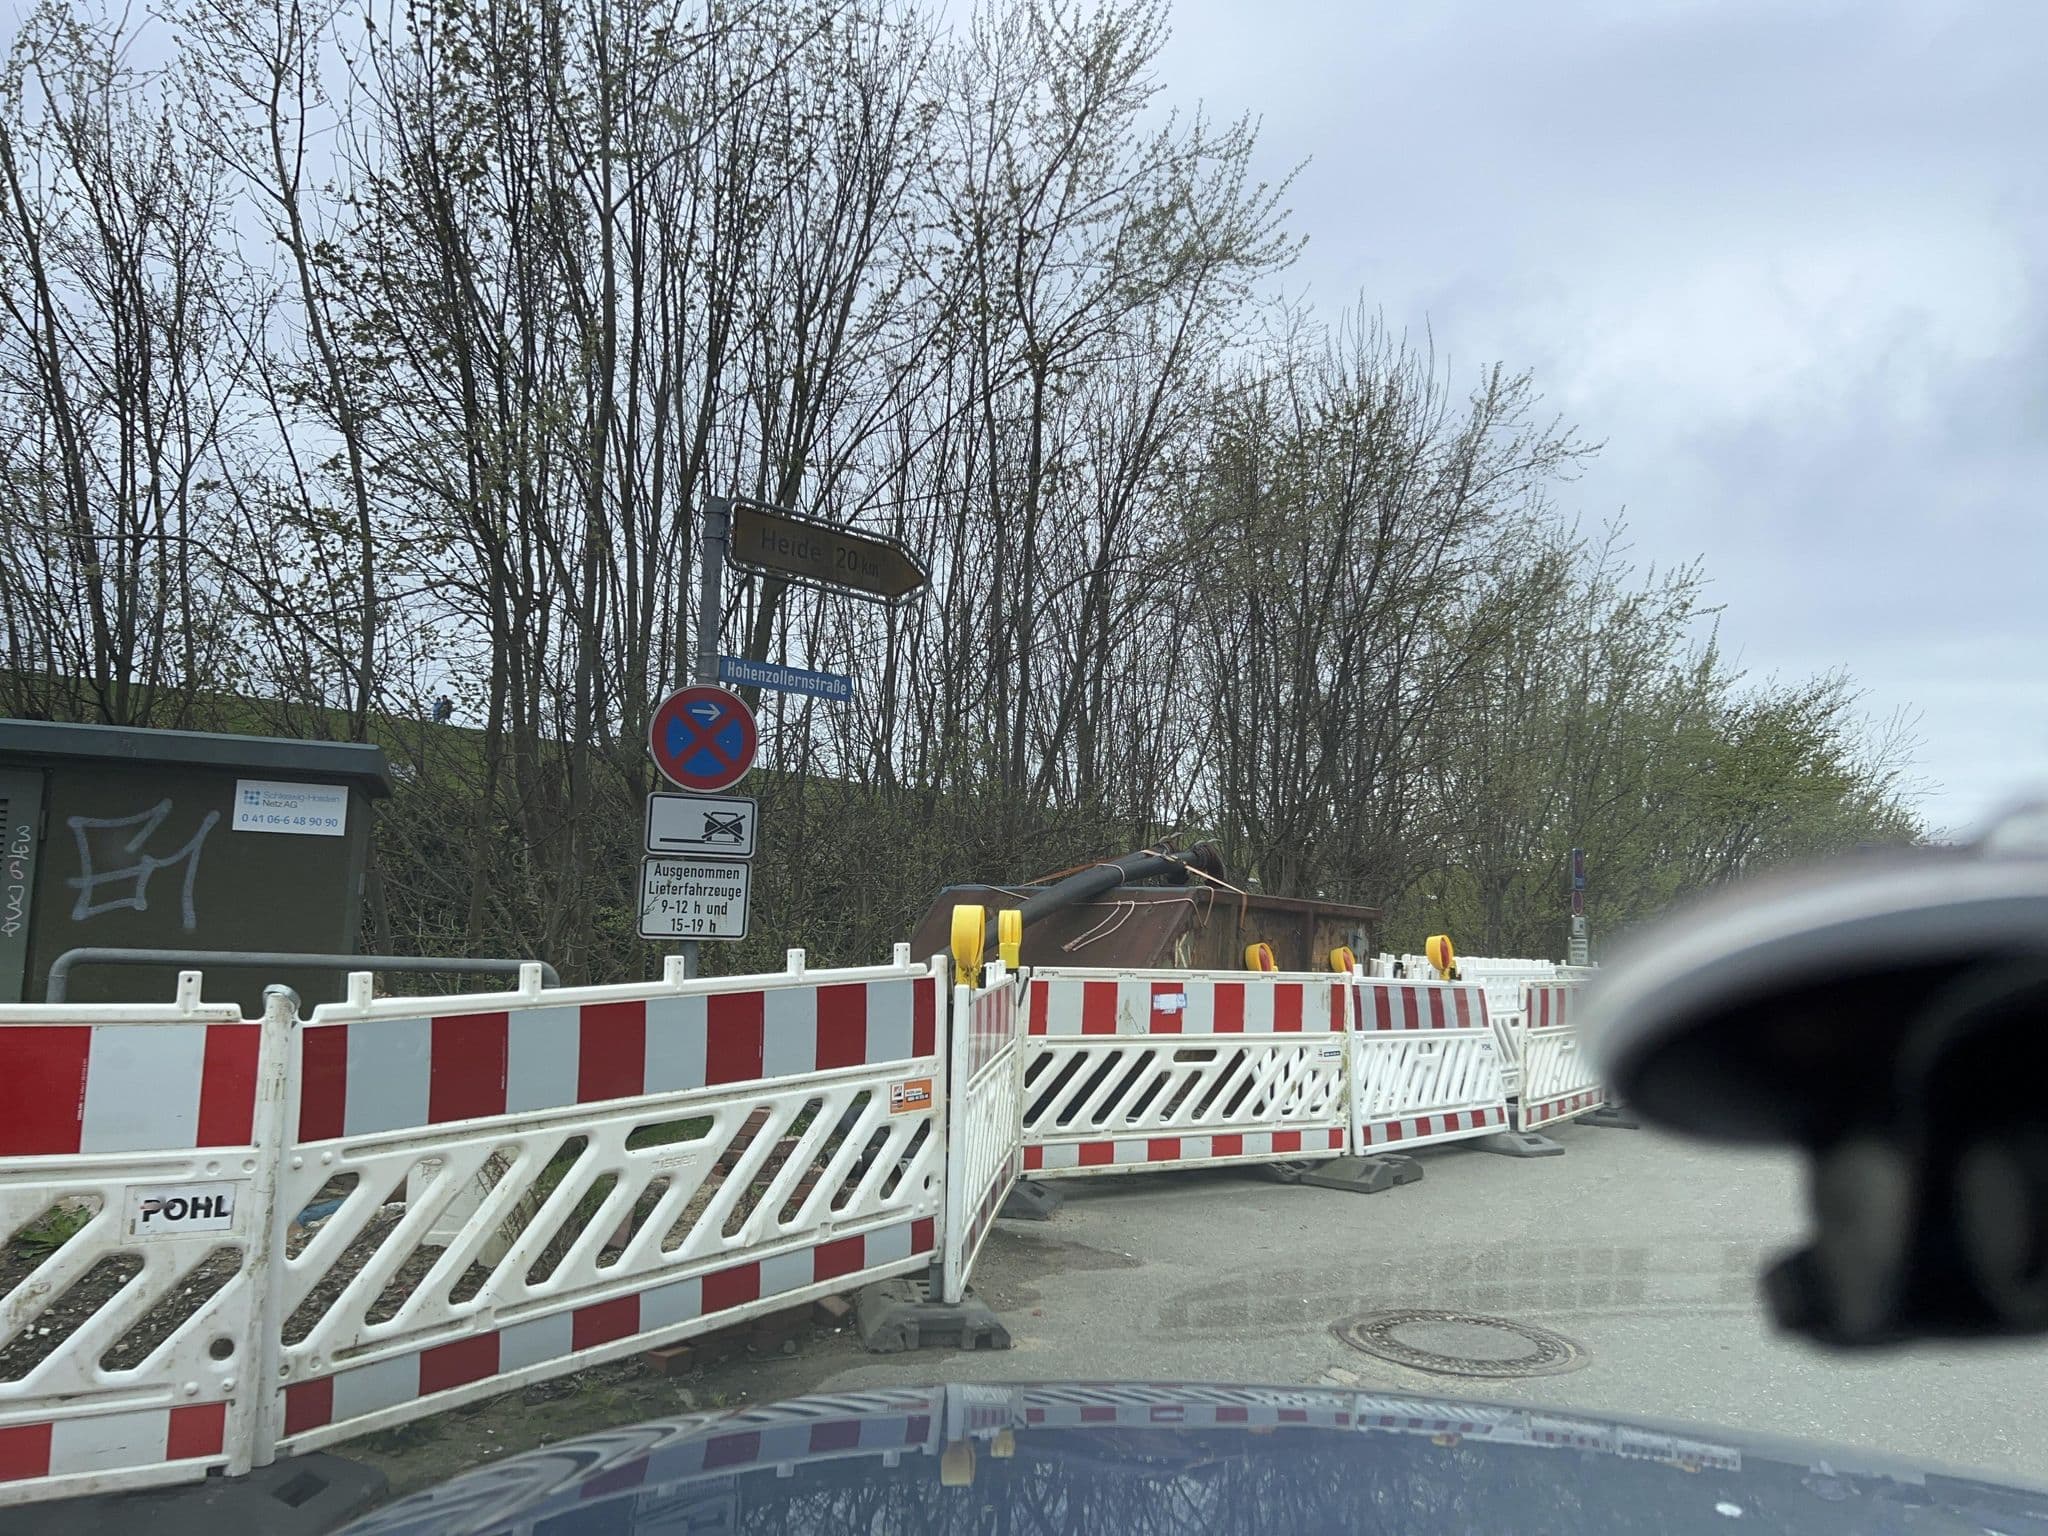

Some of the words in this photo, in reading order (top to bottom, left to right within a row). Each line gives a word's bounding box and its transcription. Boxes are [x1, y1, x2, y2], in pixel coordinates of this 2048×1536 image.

[761, 528, 823, 562] Heide
[836, 547, 857, 571] 20
[862, 557, 880, 577] km
[727, 660, 847, 696] Hohenzollernstraße
[263, 799, 283, 808] Netz
[284, 800, 298, 808] AG
[241, 813, 249, 823] 0
[252, 814, 264, 823] 41
[309, 817, 322, 827] 90
[325, 818, 338, 828] 90
[654, 863, 740, 881] Ausgenommen
[648, 881, 742, 900] Lieferfahrzeuge
[661, 900, 688, 914] 9-12
[694, 901, 700, 914] h
[706, 902, 728, 916] und
[671, 918, 704, 932] 15-19
[709, 919, 716, 933] h
[140, 1195, 231, 1222] POHL
